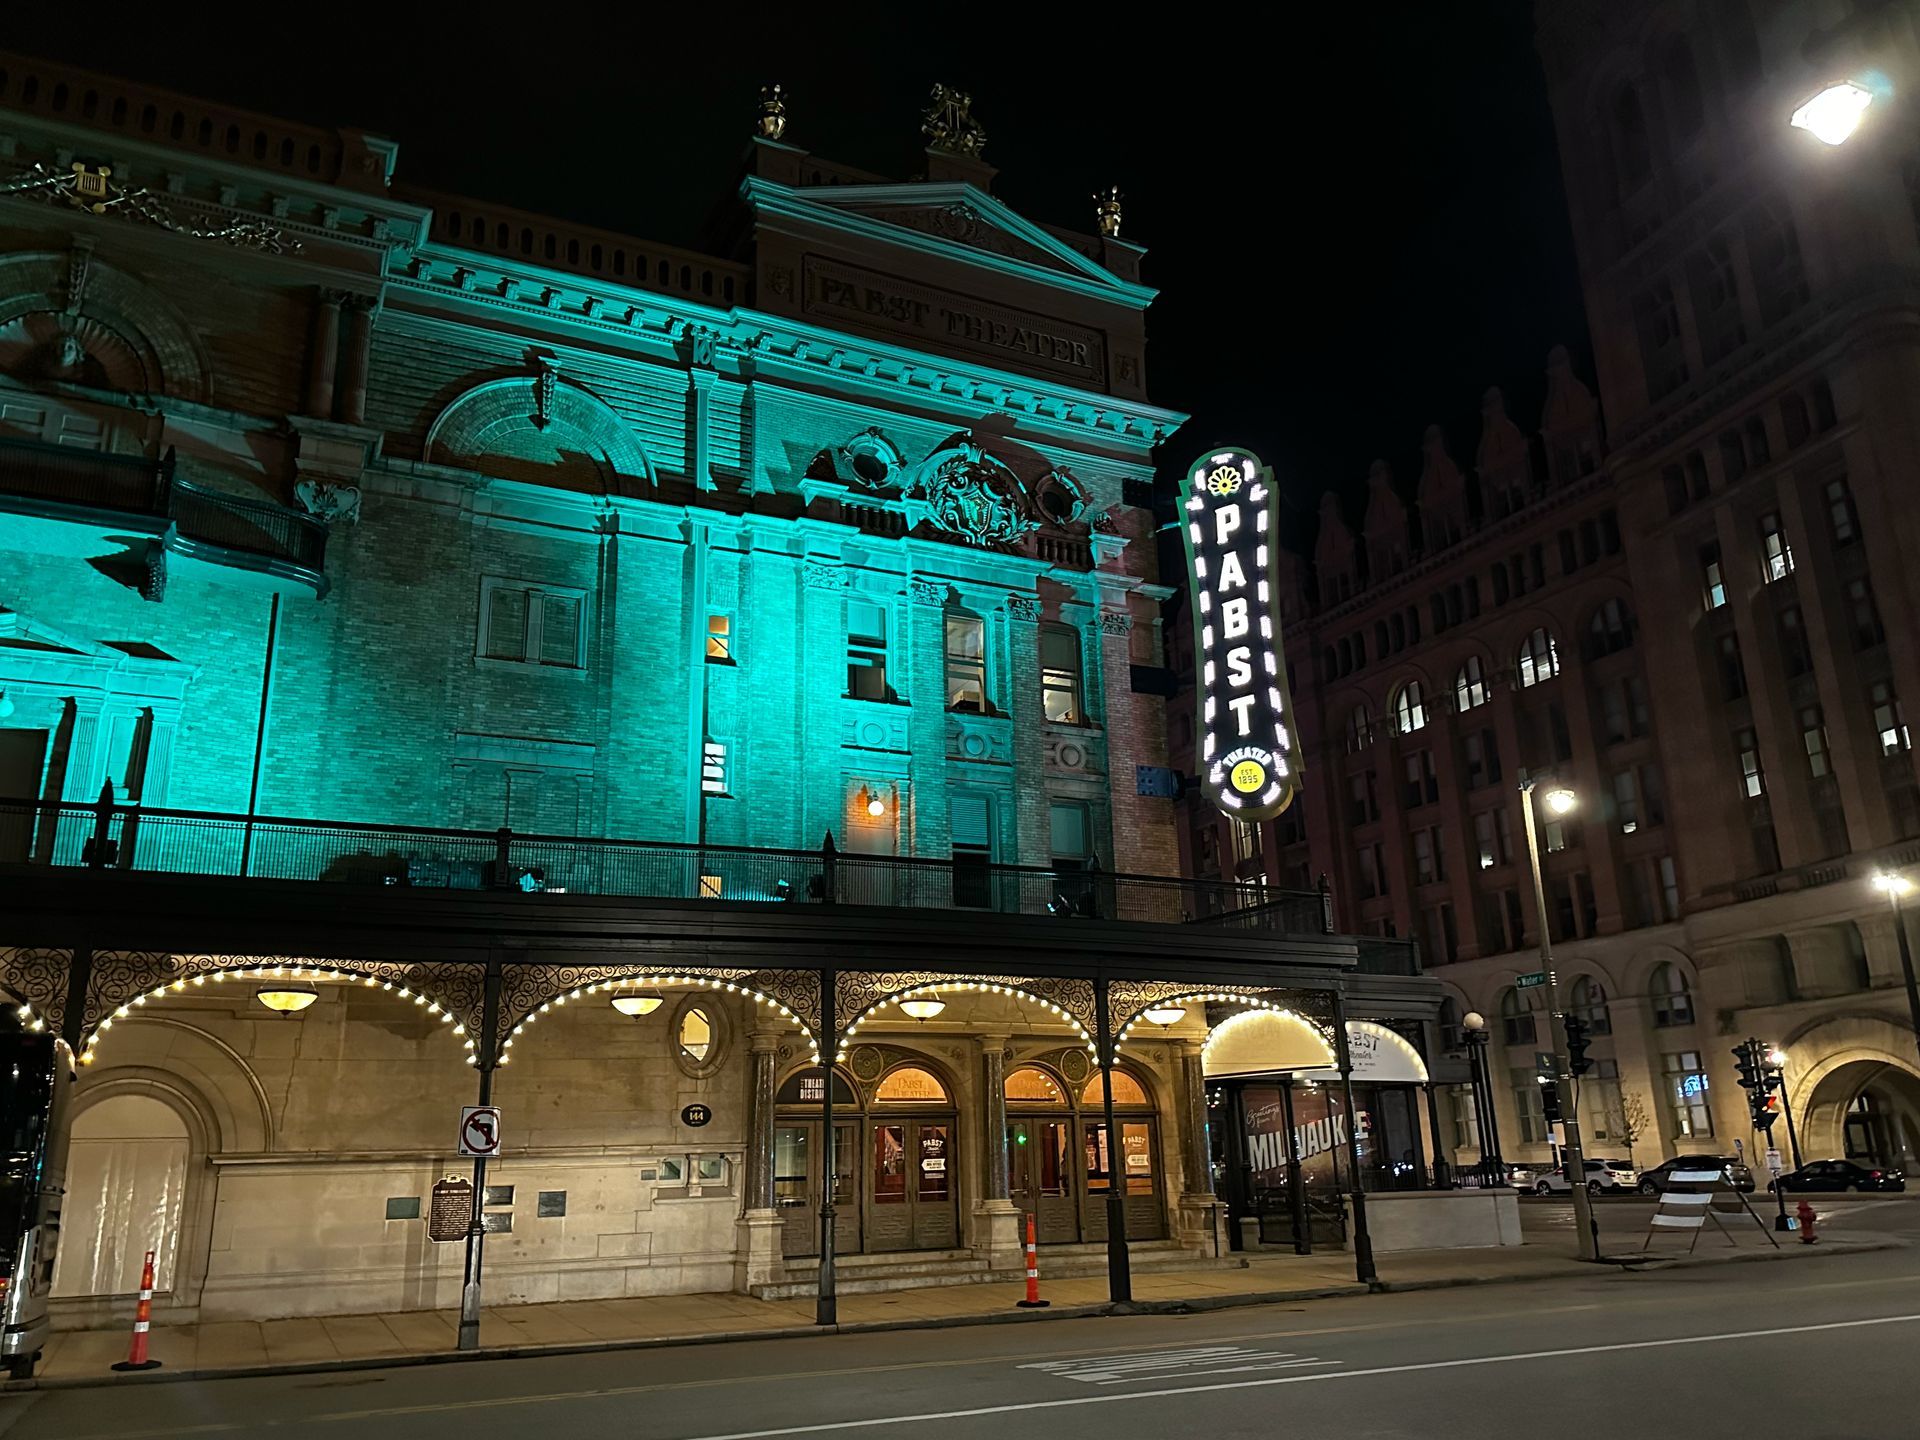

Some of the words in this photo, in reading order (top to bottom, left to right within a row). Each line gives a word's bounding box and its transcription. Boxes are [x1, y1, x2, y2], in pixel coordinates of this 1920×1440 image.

[819, 277, 931, 329] PABST
[940, 308, 1093, 369] THEATER
[1214, 503, 1256, 736] PABST
[1222, 746, 1272, 767] THEATER
[1240, 768, 1254, 776] EST
[898, 1078, 923, 1089] PABST
[922, 1139, 944, 1148] PABST
[1127, 1136, 1146, 1144] PABST
[1248, 1111, 1369, 1173] MILWAUKE
